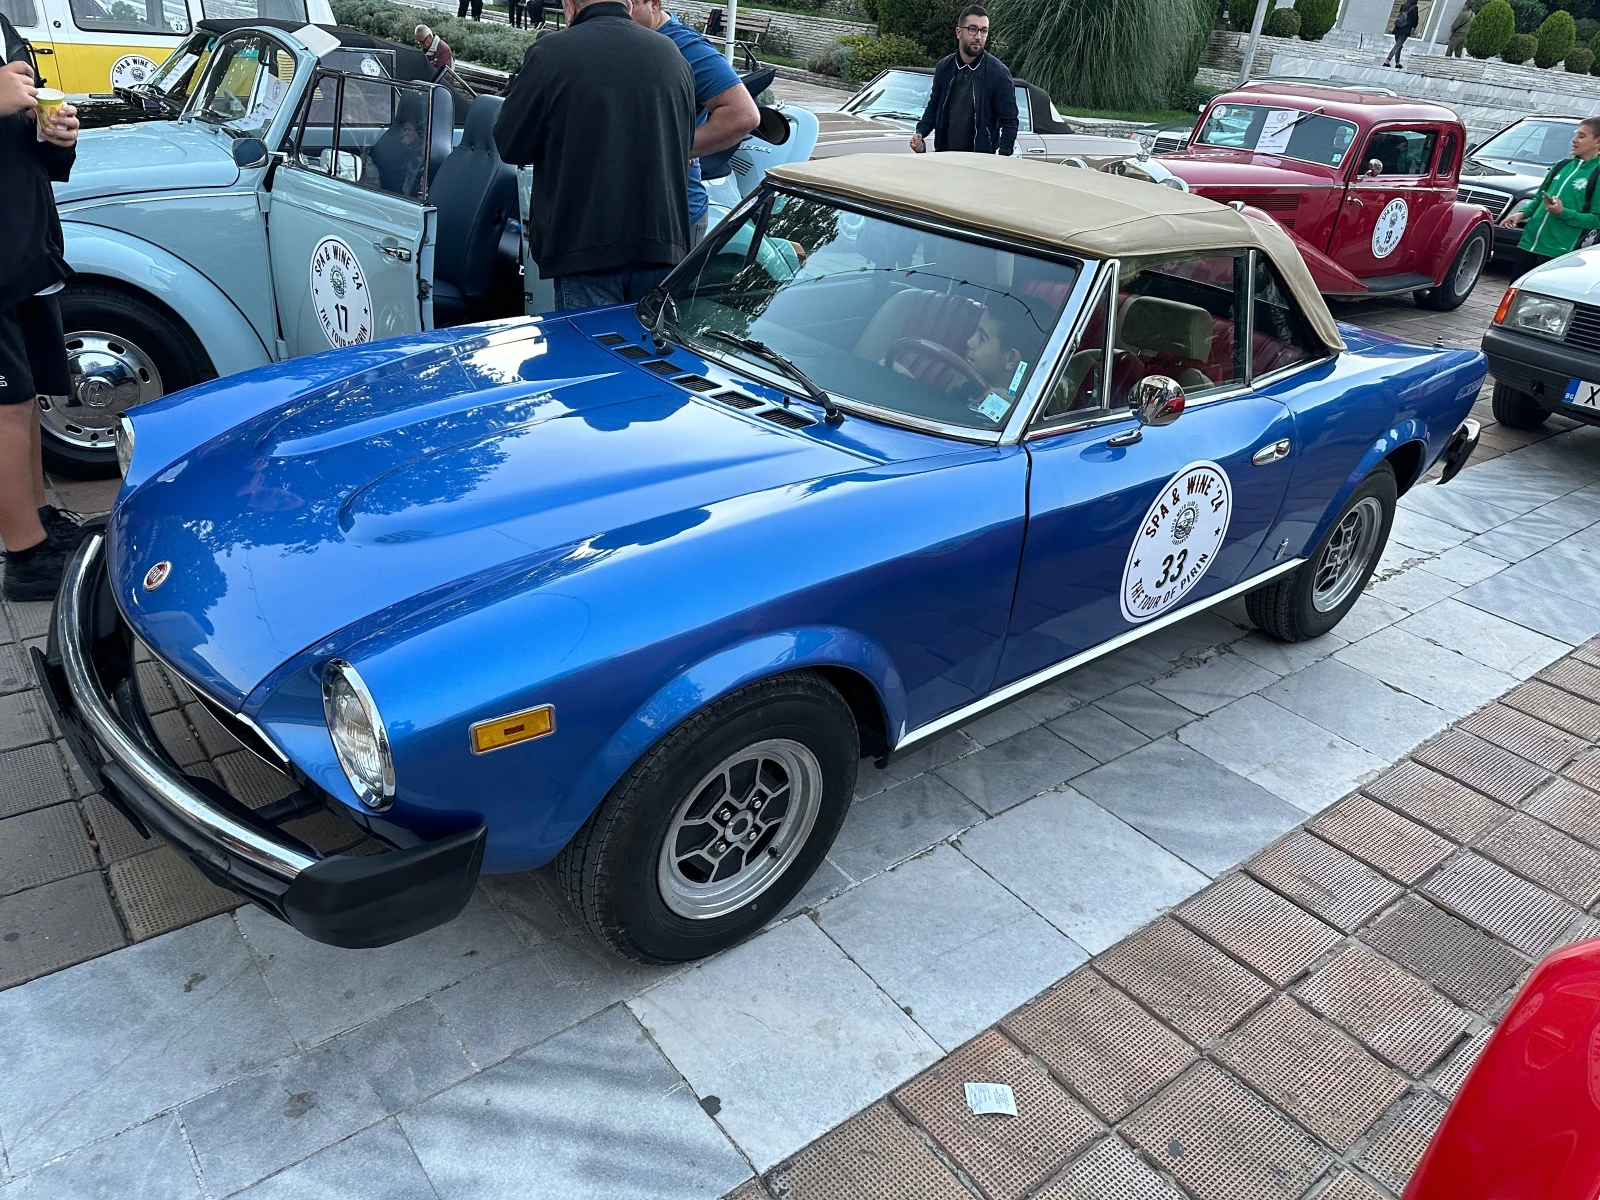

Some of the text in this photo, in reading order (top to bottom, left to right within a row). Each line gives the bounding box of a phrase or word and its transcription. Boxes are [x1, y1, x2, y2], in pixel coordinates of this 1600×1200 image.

[115, 62, 126, 74] SPA
[132, 58, 149, 68] WINE
[1384, 230, 1393, 244] 19
[314, 253, 326, 277] SPA
[324, 246, 331, 260] &
[332, 245, 352, 270] WINE
[319, 307, 331, 330] THE
[331, 328, 347, 348] TOUR
[354, 324, 368, 346] PIRIN
[334, 303, 348, 333] 17
[1584, 386, 1600, 406] X
[1145, 503, 1169, 538] SPA
[1171, 487, 1181, 506] &
[1187, 474, 1215, 497] WINE
[1131, 553, 1209, 610] THE TOUR OF PIRIN
[1155, 548, 1188, 589] 33
